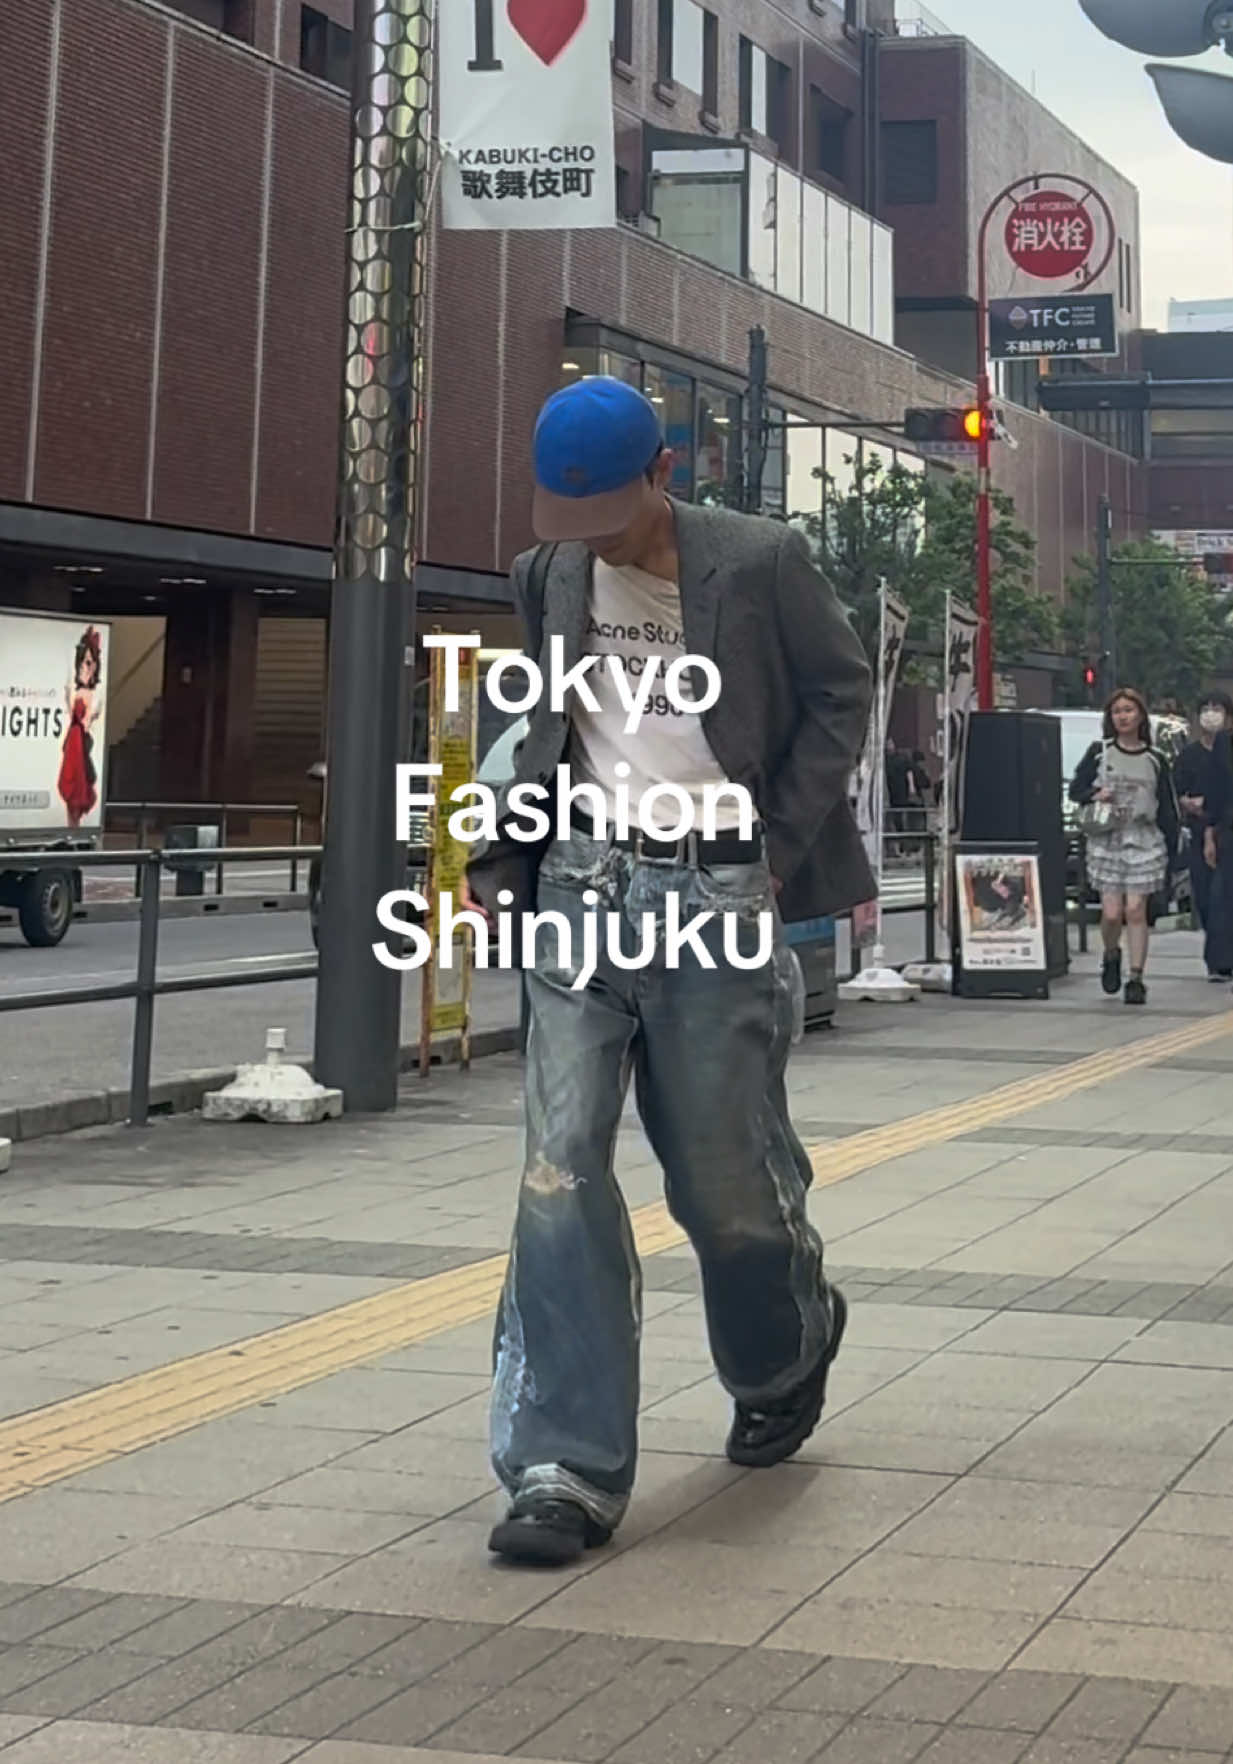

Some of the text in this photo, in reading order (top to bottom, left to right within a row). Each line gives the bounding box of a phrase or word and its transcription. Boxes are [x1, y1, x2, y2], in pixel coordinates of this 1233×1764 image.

[458, 145, 595, 165] KABUKI-CHO
[460, 168, 594, 200] 歌舞伎町
[1012, 217, 1088, 252] 消火栓
[1029, 307, 1070, 328] TFC
[586, 619, 640, 641] Acne
